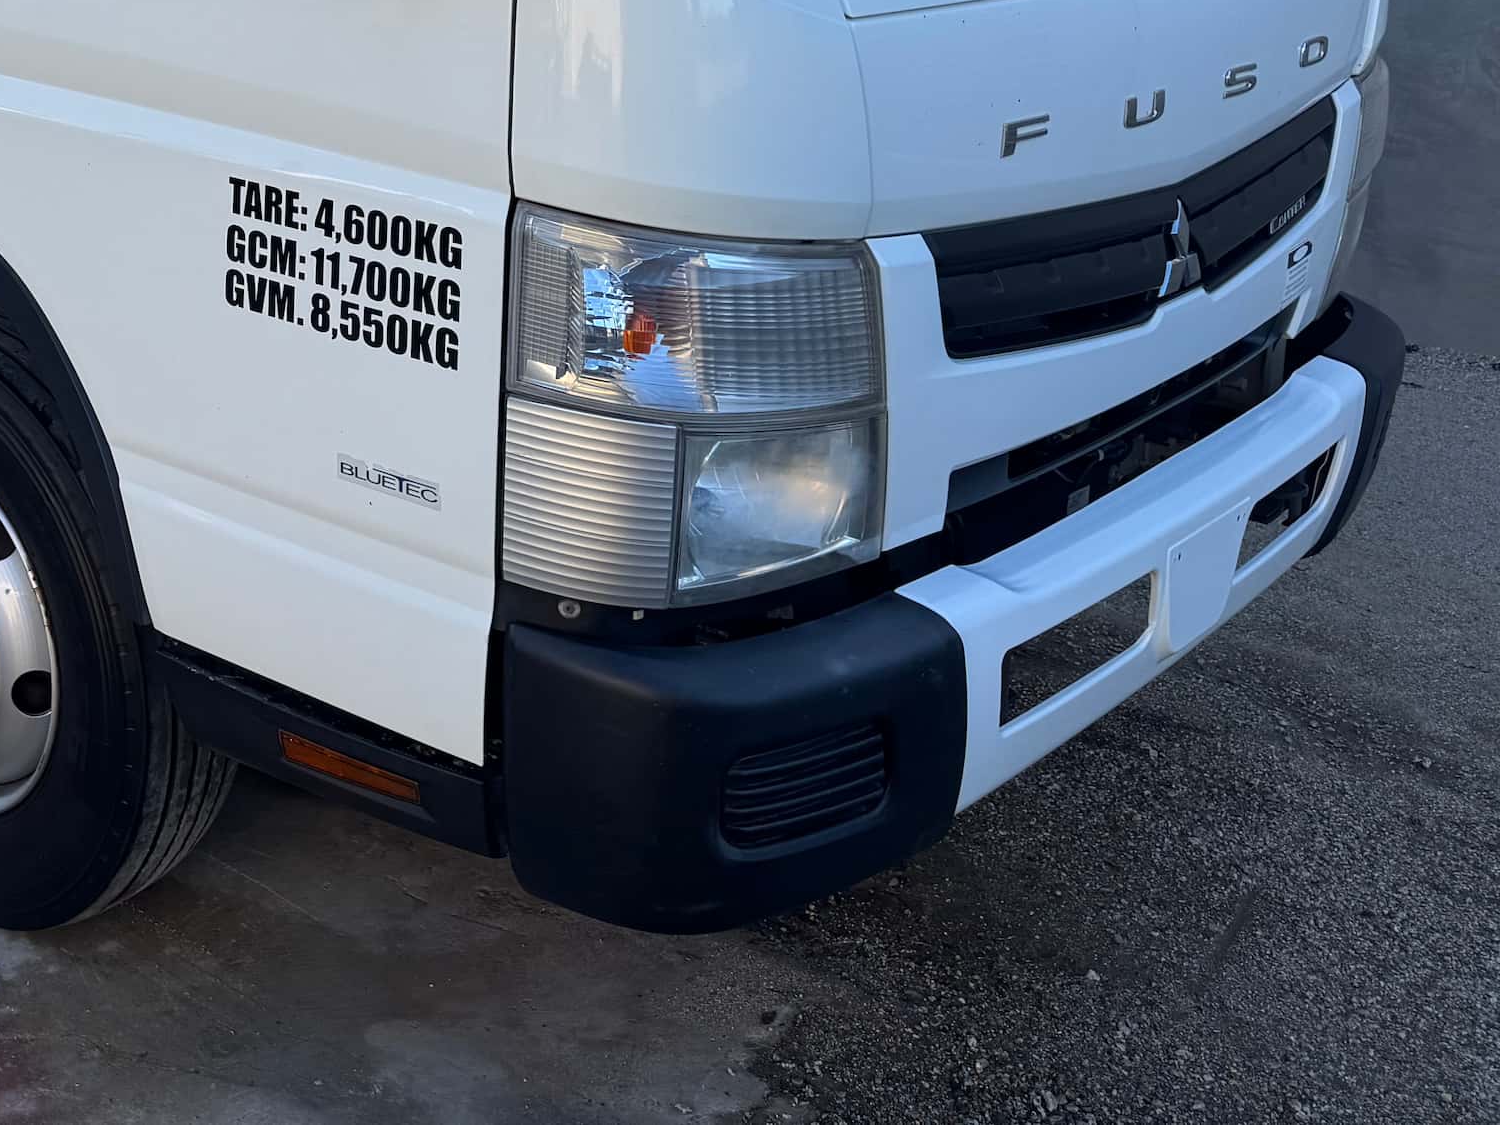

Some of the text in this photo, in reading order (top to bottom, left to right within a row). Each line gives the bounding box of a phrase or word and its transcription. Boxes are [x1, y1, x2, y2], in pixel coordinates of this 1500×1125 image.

[999, 35, 1330, 160] FUSO
[228, 176, 463, 271] TARE: 4,600KG
[225, 268, 459, 371] GVM. 8,550KG
[226, 224, 461, 323] GCM: 11,700KG
[340, 461, 439, 504] BLUETEC
